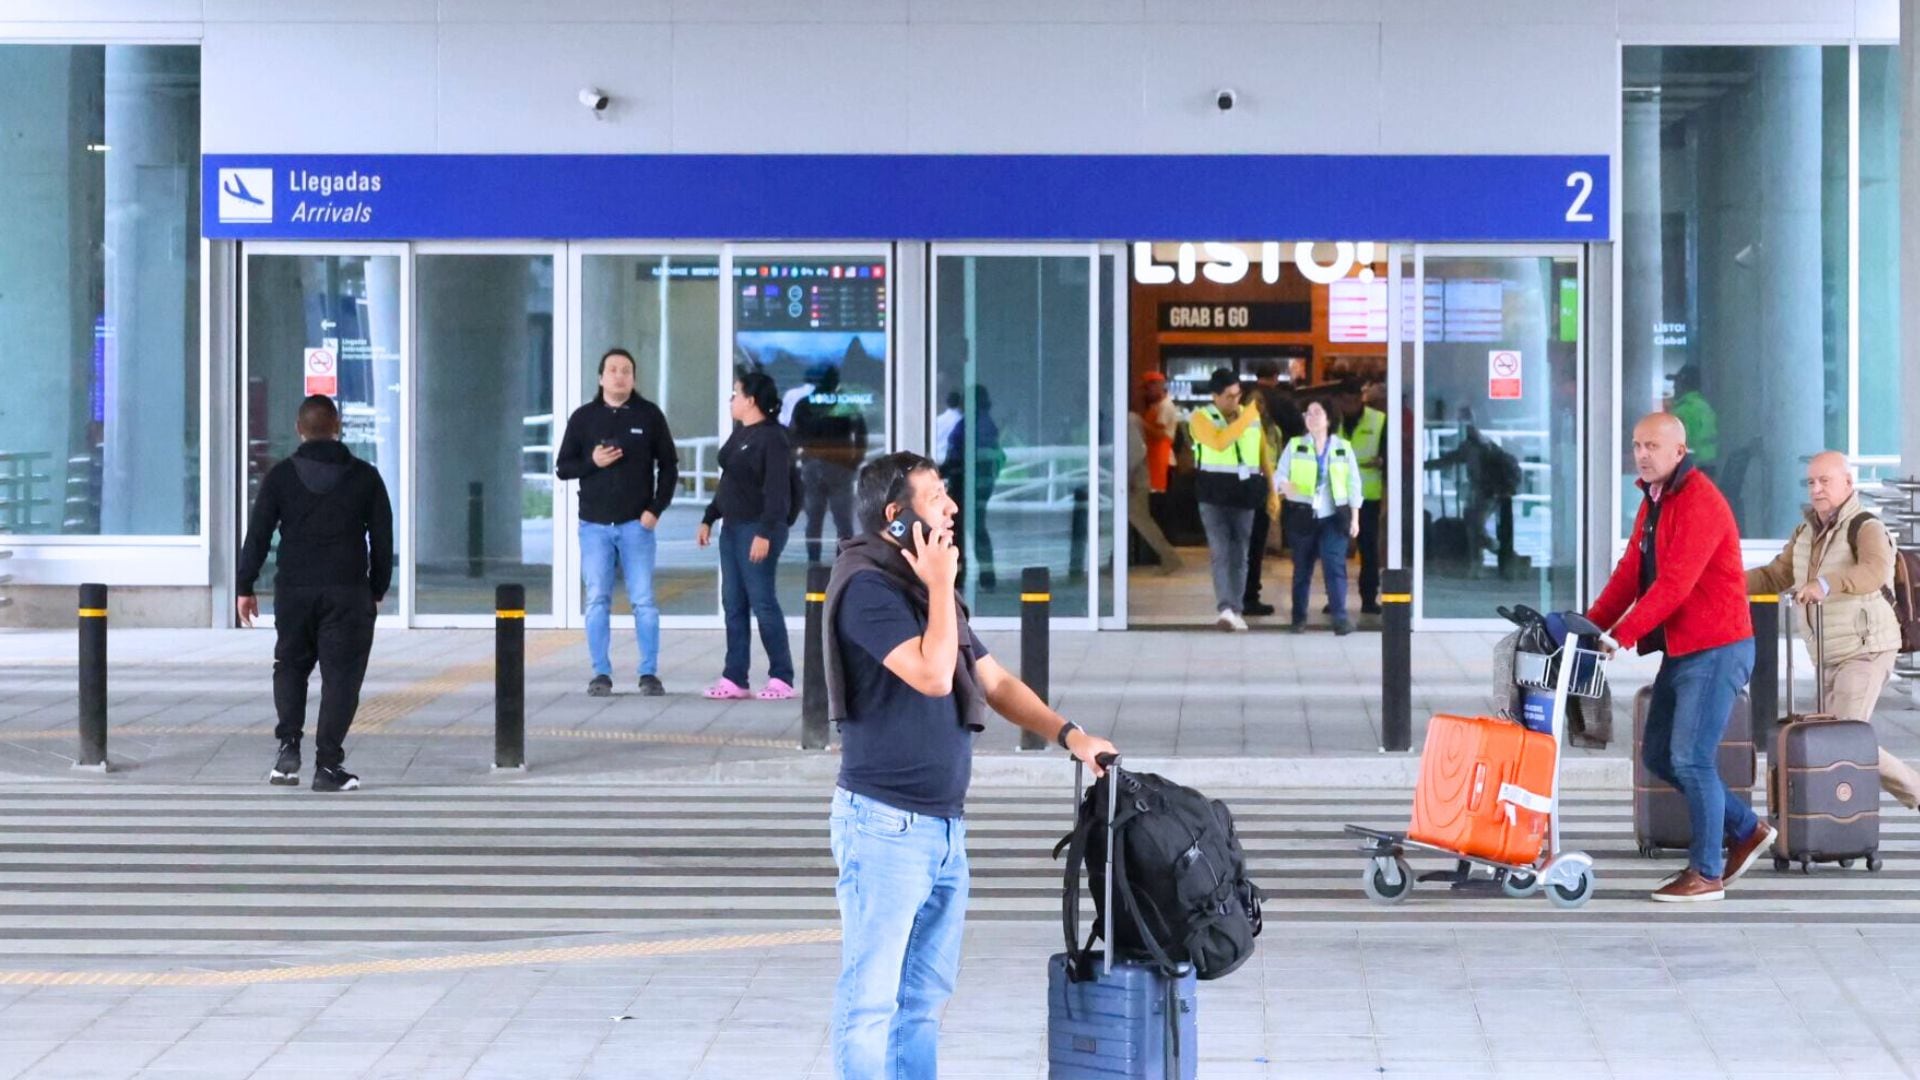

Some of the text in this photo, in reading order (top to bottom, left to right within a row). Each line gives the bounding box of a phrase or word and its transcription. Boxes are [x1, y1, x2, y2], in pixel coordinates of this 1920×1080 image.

[290, 170, 381, 197] Llegadas
[1565, 171, 1593, 222] 2
[291, 201, 372, 223] Arrivals
[1170, 306, 1249, 327] GRAB & GO
